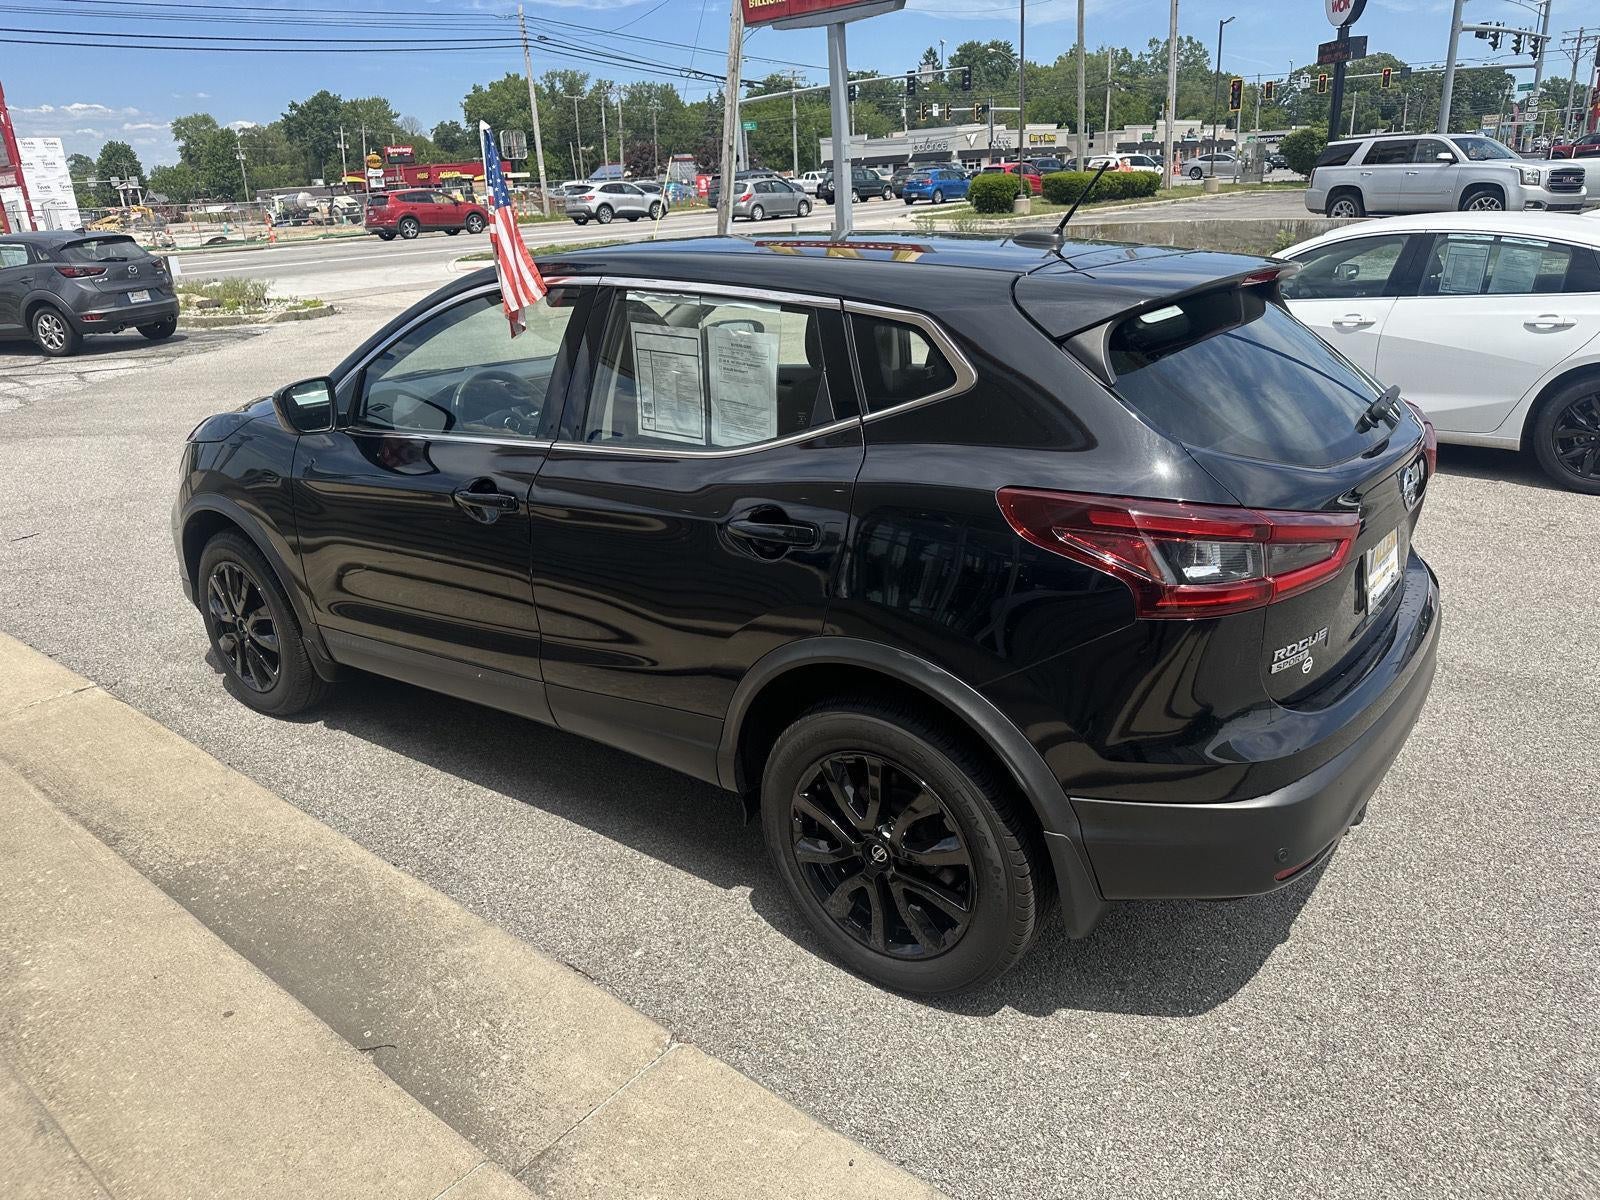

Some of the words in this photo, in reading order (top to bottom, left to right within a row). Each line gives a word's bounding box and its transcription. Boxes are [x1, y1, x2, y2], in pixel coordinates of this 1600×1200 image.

[748, 0, 786, 9] BILLI
[1331, 0, 1350, 13] WOK
[1248, 135, 1285, 143] eterprise
[387, 146, 413, 154] Speedway
[1273, 626, 1328, 662] ROGUE
[1273, 650, 1309, 673] SPORT
